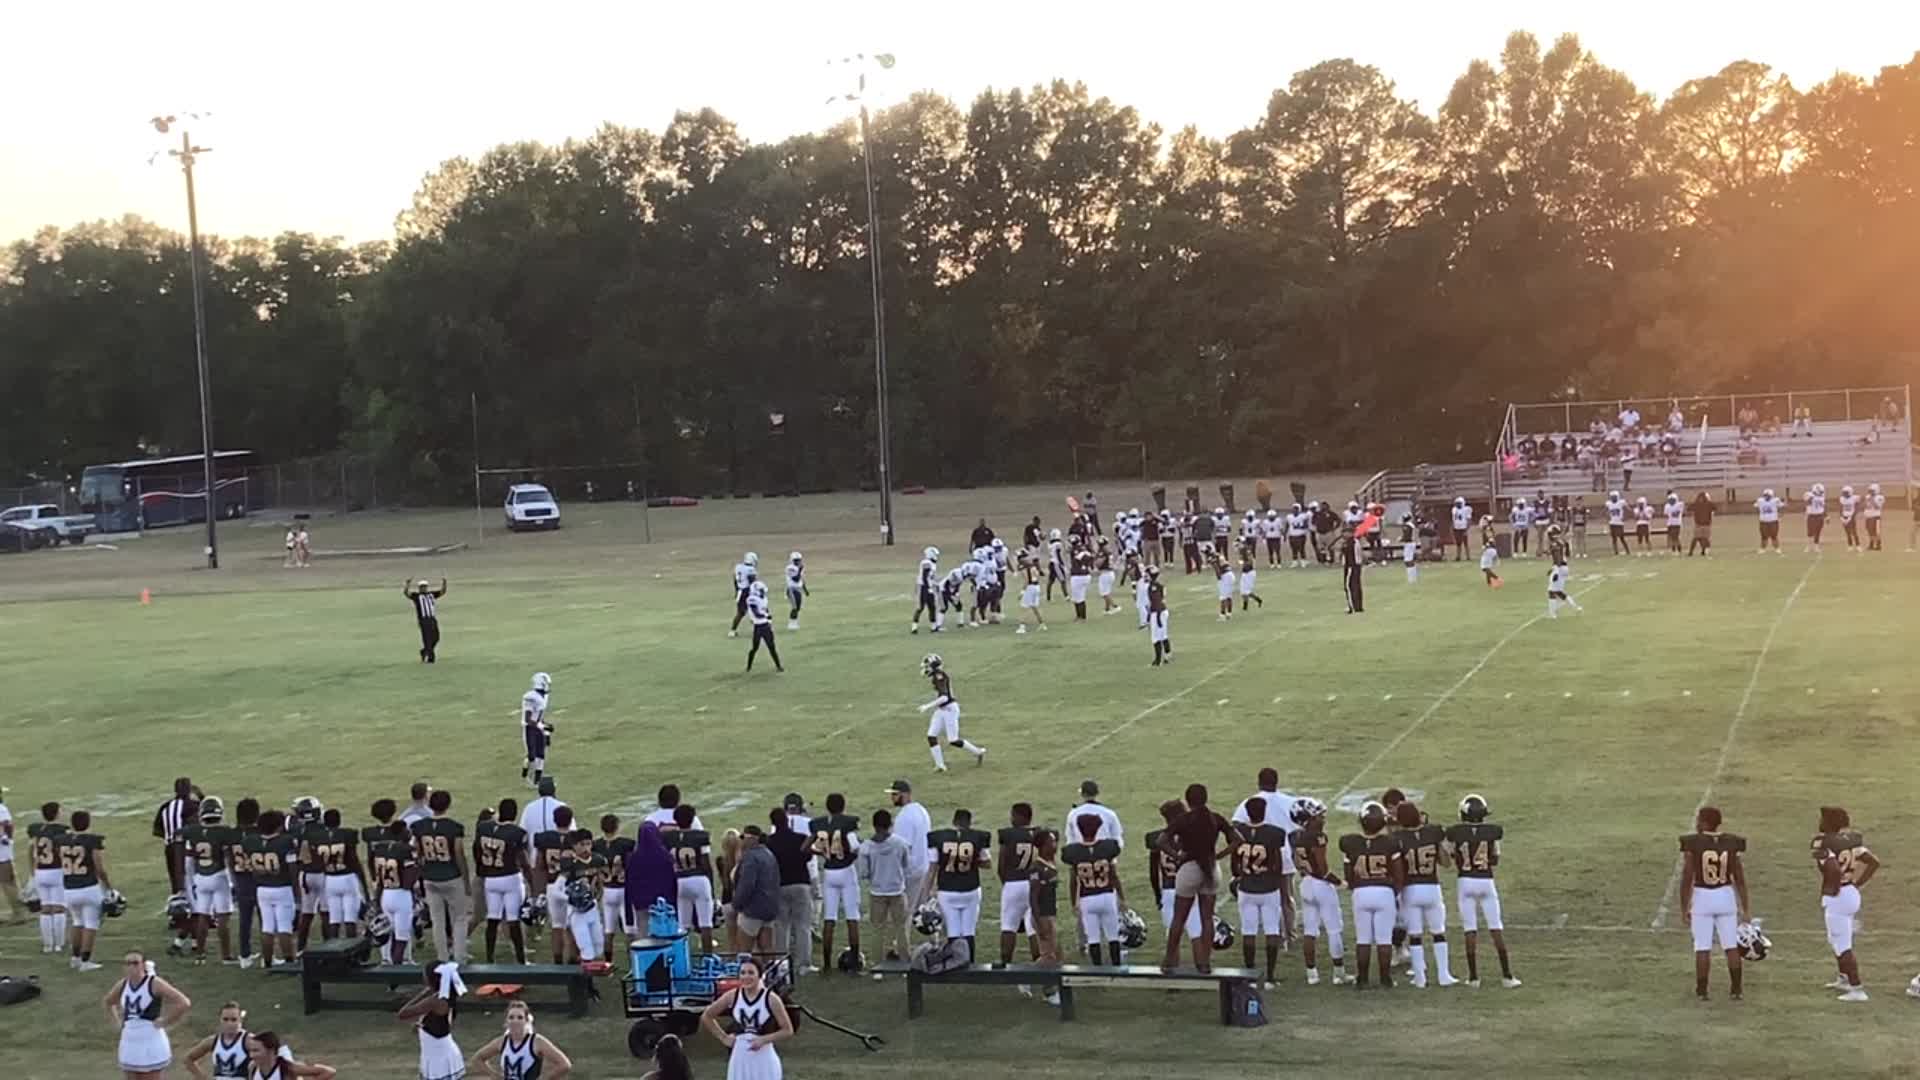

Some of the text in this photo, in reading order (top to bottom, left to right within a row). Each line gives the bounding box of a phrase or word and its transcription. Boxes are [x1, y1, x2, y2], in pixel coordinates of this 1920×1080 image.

[943, 842, 974, 872] 79
[1406, 845, 1437, 875] 15
[1458, 841, 1490, 870] 14
[1702, 850, 1728, 885] 61
[125, 995, 142, 1017] M
[740, 1008, 761, 1031] M
[215, 1053, 238, 1075] M
[503, 1055, 524, 1080] M
